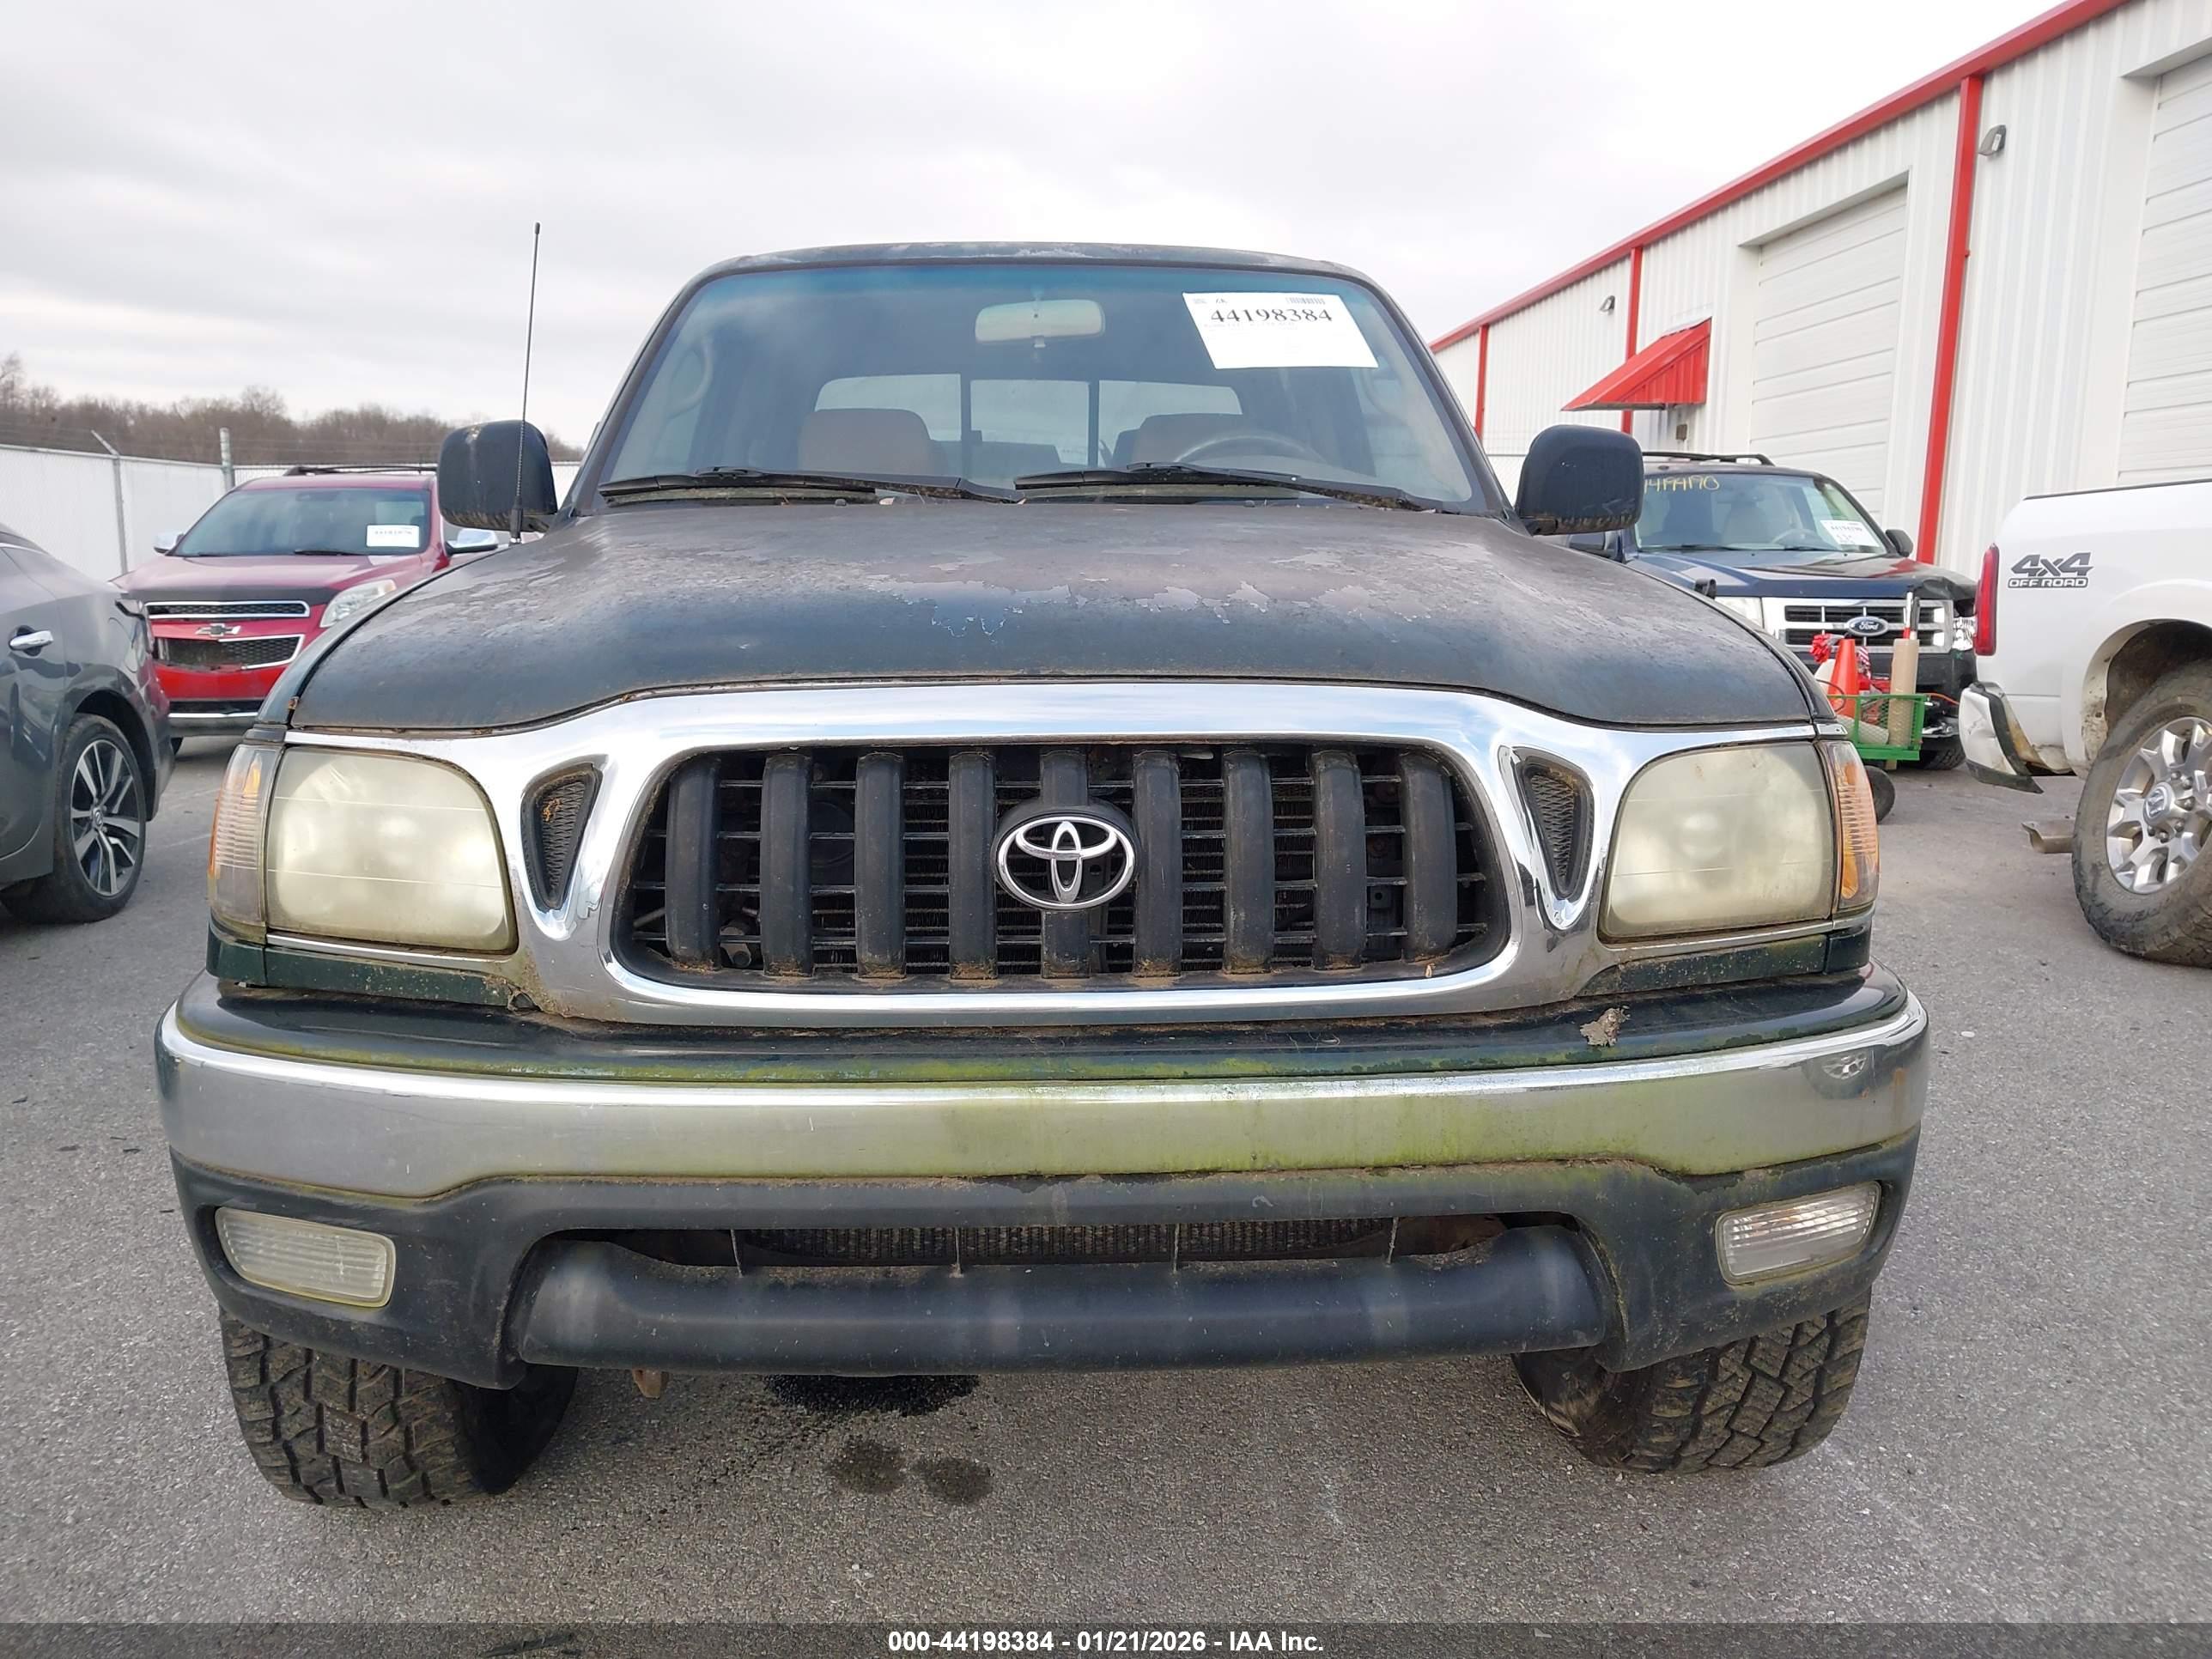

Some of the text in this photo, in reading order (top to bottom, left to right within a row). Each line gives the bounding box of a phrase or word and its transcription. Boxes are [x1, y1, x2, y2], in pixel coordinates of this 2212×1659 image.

[1210, 308, 1333, 323] 44198384
[2010, 552, 2094, 576] 4x4
[2009, 578, 2087, 587] OFF ROAD
[1858, 621, 1879, 630] Ford
